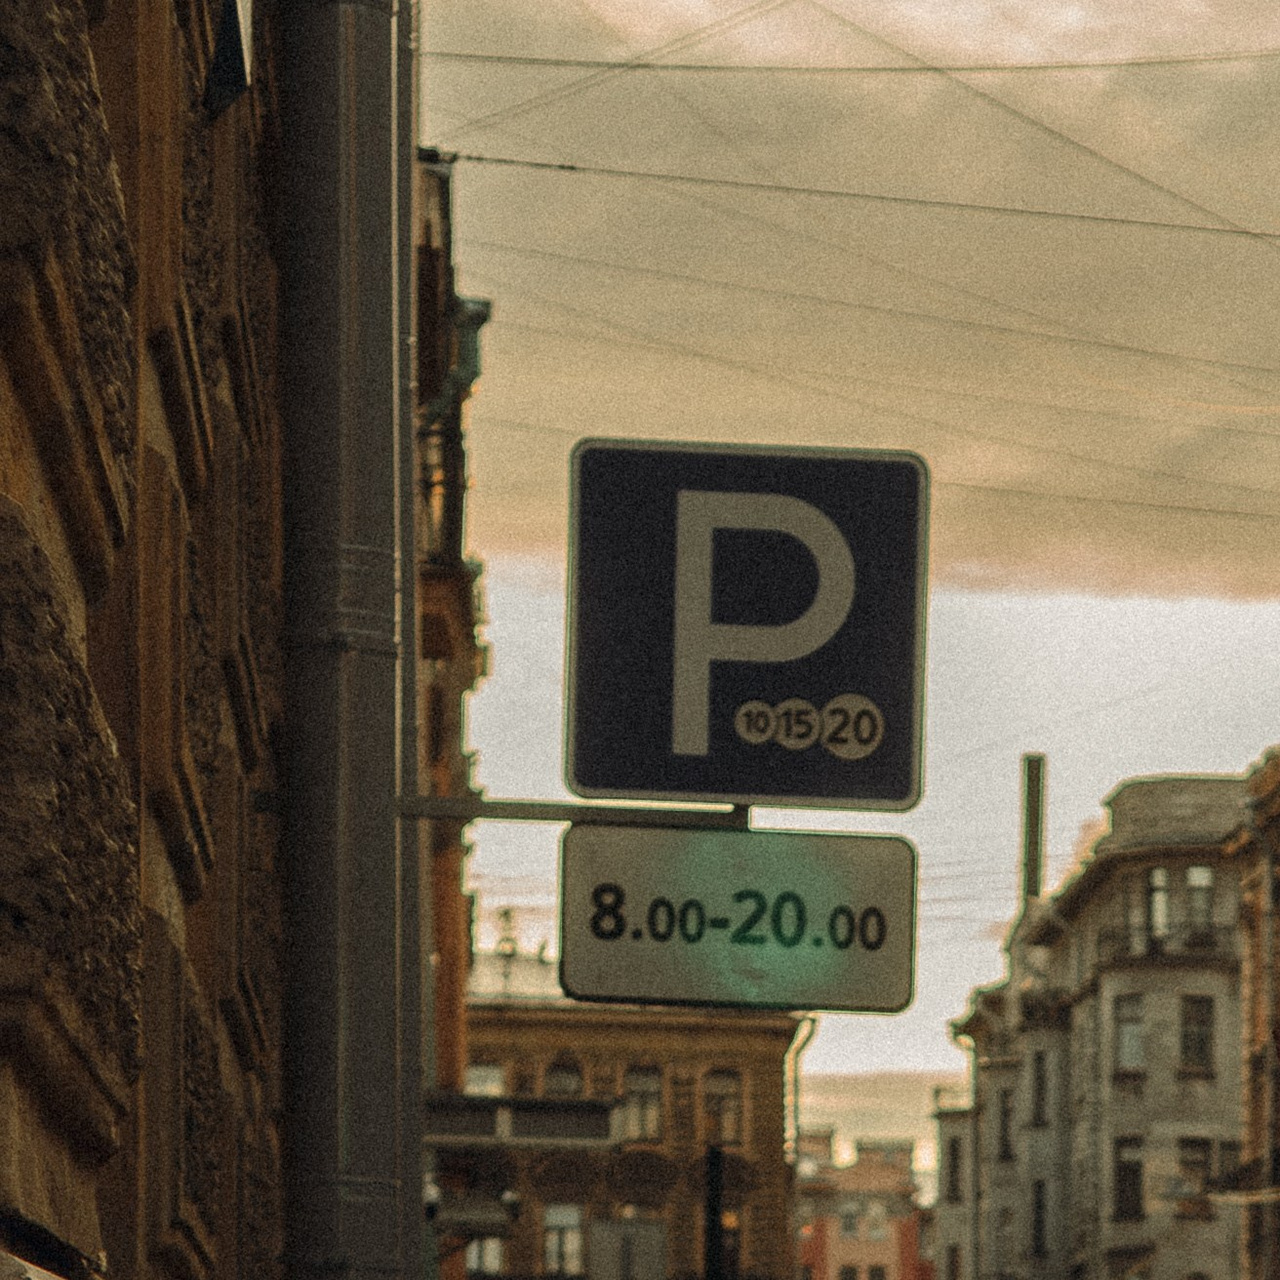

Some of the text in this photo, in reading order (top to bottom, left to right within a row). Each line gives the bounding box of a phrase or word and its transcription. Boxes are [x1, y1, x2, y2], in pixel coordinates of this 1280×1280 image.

[671, 488, 856, 757] P
[743, 707, 877, 745] 10 15 20
